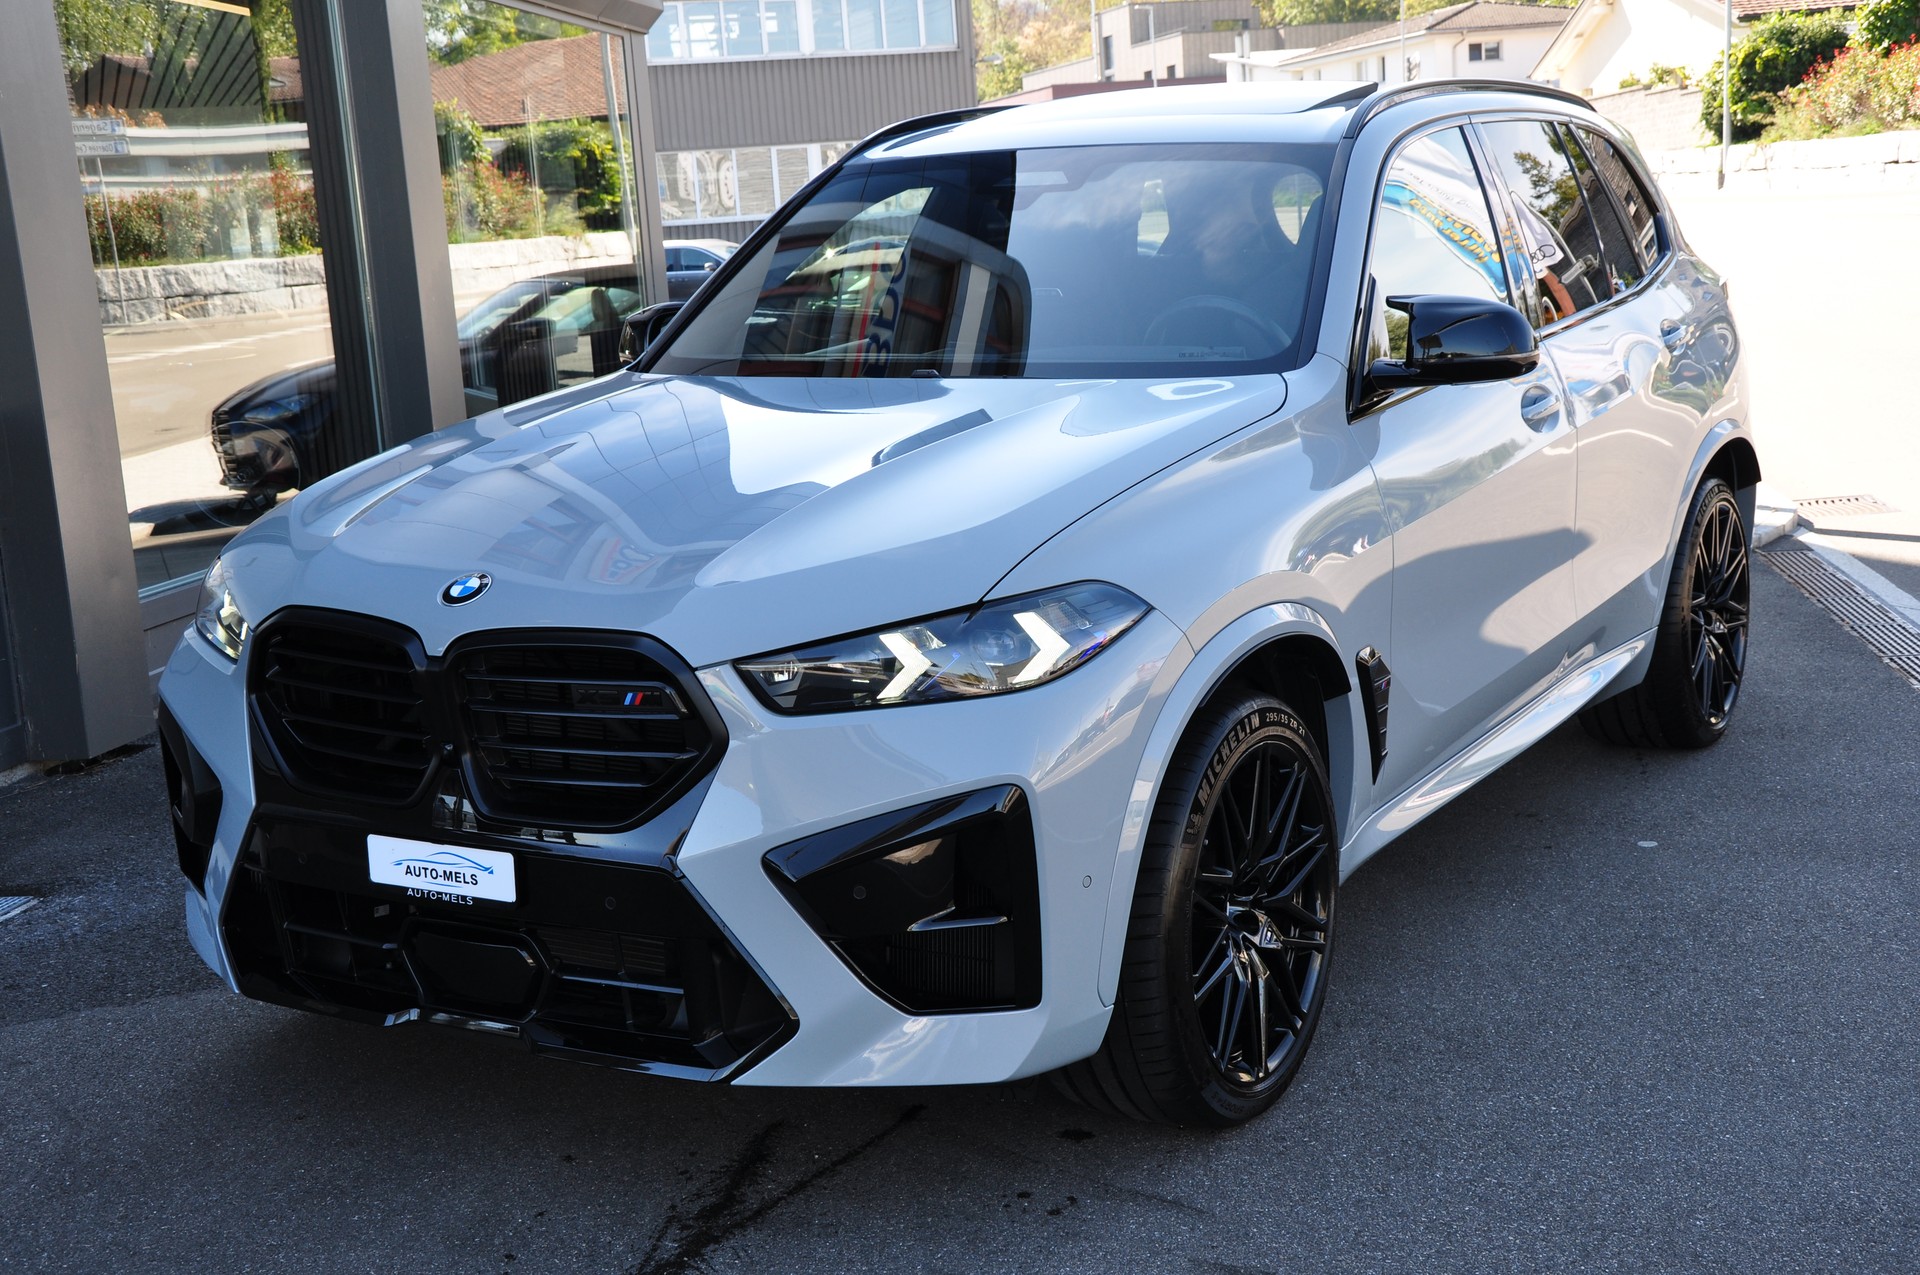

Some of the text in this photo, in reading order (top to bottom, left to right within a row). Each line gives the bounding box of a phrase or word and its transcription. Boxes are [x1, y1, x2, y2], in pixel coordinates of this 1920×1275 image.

[1198, 712, 1260, 807] MICHELIN
[1266, 712, 1288, 724] 295/35
[1290, 718, 1298, 730] ZR
[1299, 726, 1306, 737] 21
[405, 865, 478, 886] AUTO-MELS
[407, 888, 474, 905] AUTO-MELS
